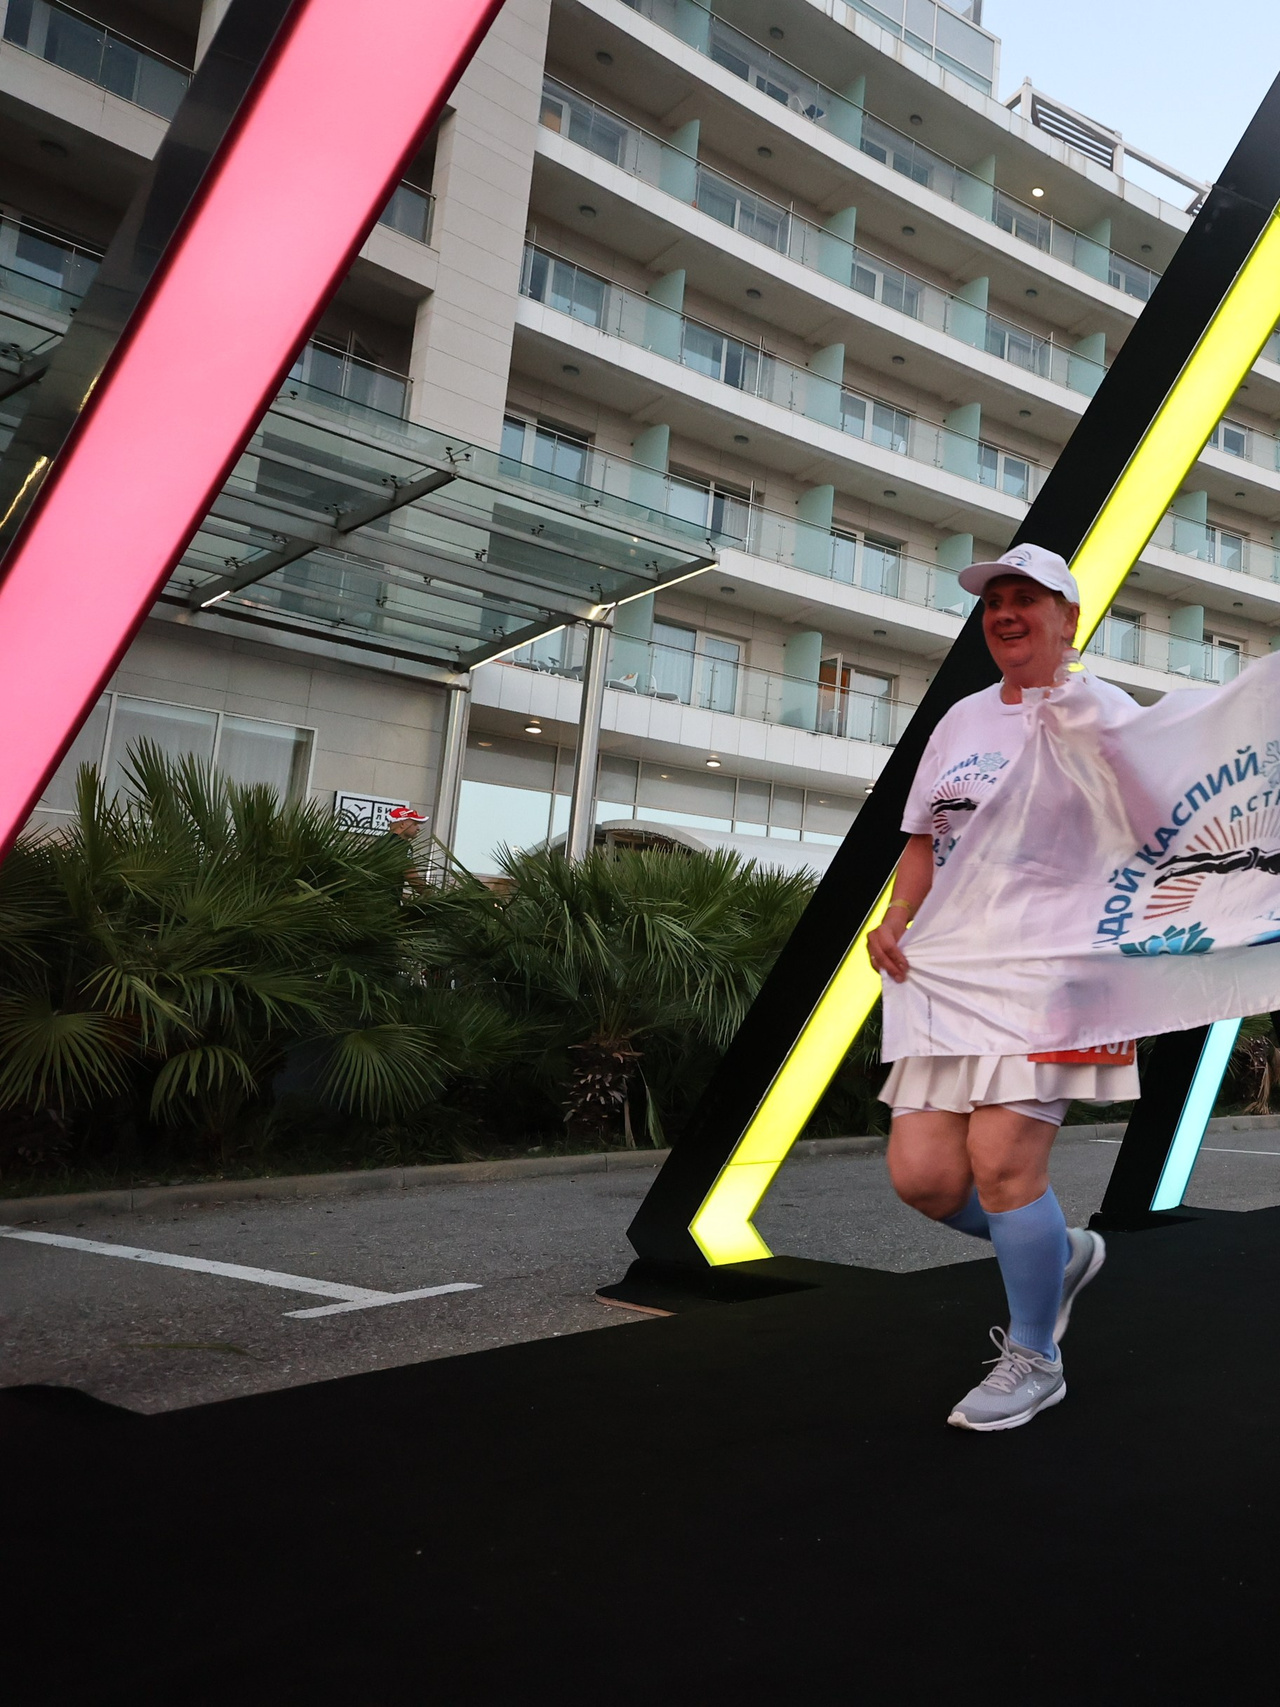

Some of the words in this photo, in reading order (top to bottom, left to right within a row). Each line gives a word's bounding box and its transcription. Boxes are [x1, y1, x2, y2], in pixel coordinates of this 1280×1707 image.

[952, 773, 997, 784] АСТРА
[1091, 866, 1146, 948] ДОЙ
[1135, 745, 1260, 866] КАСПИЙ
